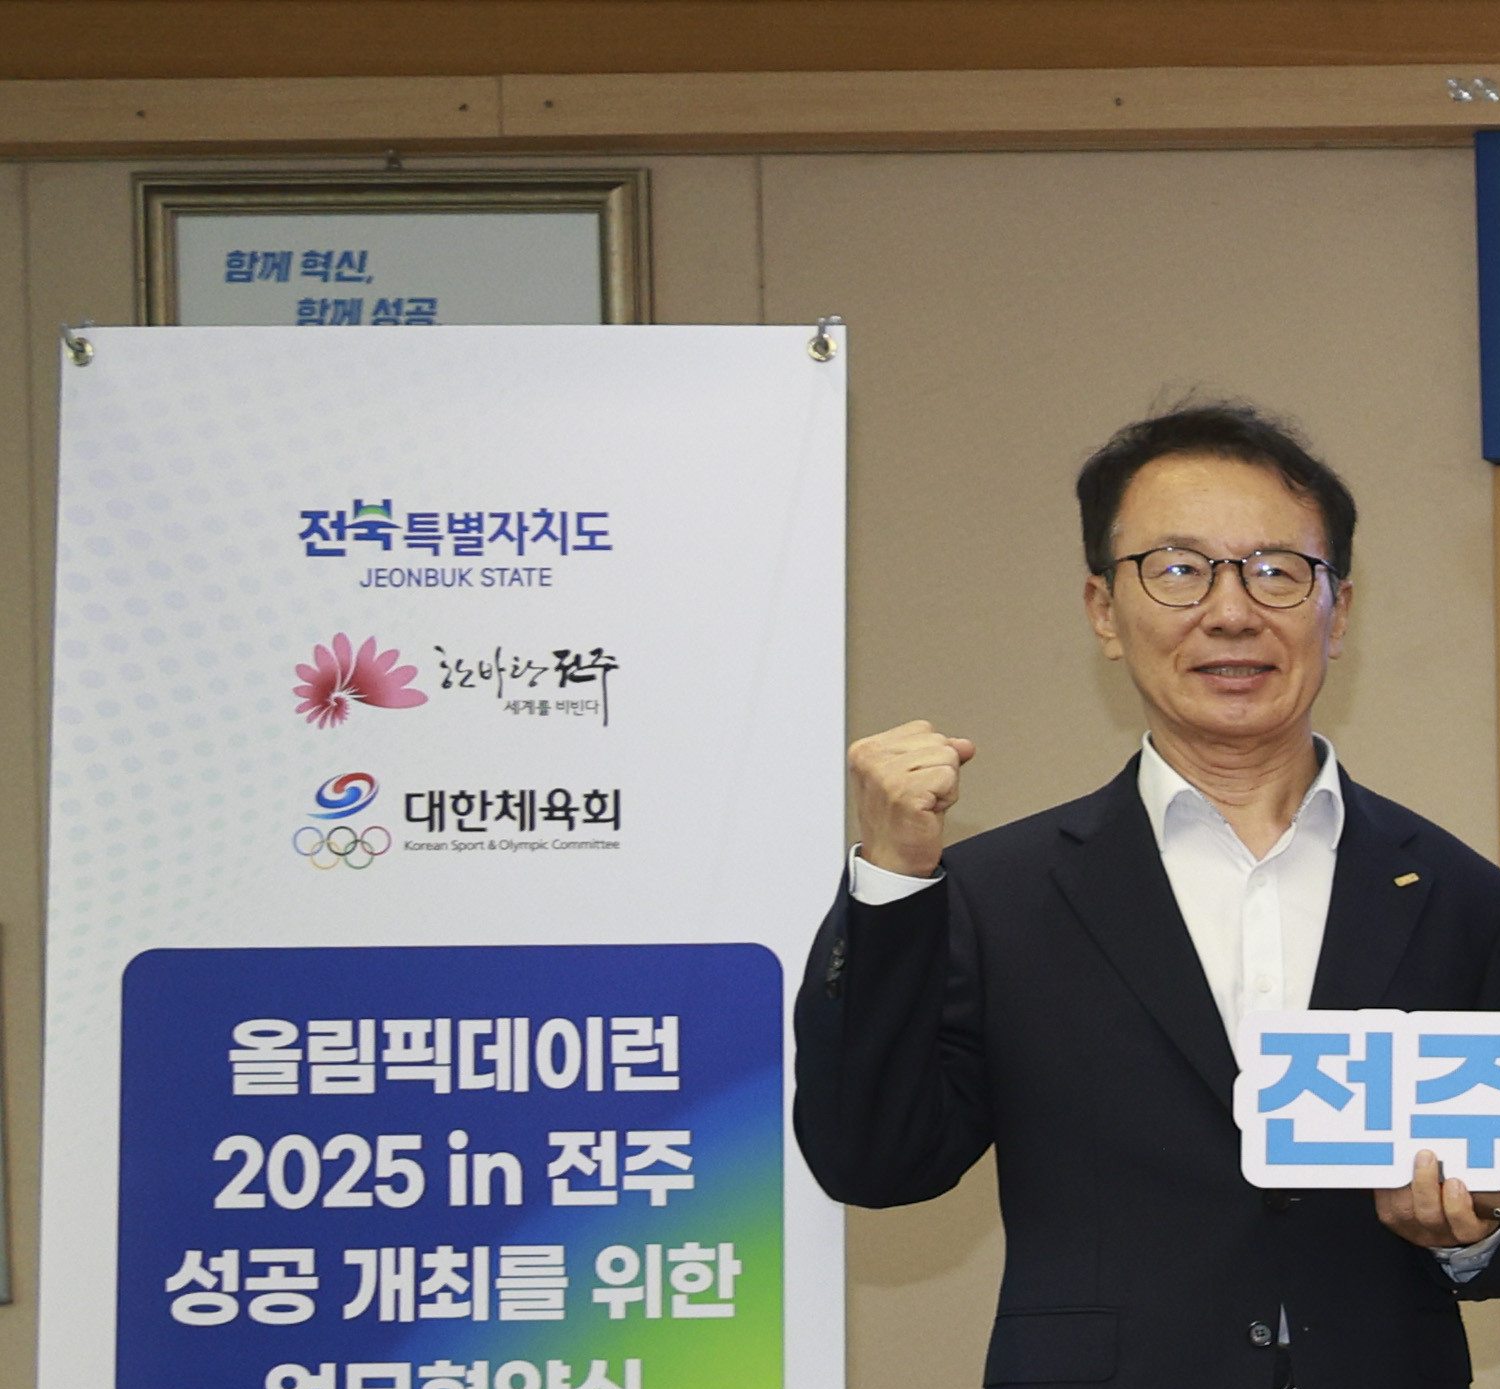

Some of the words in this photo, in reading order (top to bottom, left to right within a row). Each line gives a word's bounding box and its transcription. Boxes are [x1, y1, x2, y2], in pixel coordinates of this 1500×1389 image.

[225, 249, 294, 284] 함께
[300, 249, 373, 285] 혁신,
[295, 297, 364, 327] 함께
[370, 297, 442, 326] 성공
[298, 498, 613, 558] 전북특별자치도
[359, 567, 474, 588] JEONBUK
[480, 567, 552, 588] STATE
[503, 699, 552, 717] 세계를
[555, 699, 600, 717] 비빈다
[552, 647, 620, 727] 전주
[405, 787, 621, 833] 대한체육회
[403, 840, 449, 852] Korean
[450, 839, 485, 853] Sport
[497, 839, 549, 853] Olympic
[550, 838, 621, 850] Committee
[229, 1015, 680, 1096] 올림픽데이런
[213, 1133, 425, 1210] 2025
[448, 1129, 523, 1207] in
[548, 1130, 695, 1207] 전주
[165, 1248, 319, 1326] 성공
[343, 1245, 569, 1323] 개최를
[592, 1242, 742, 1320] 위한
